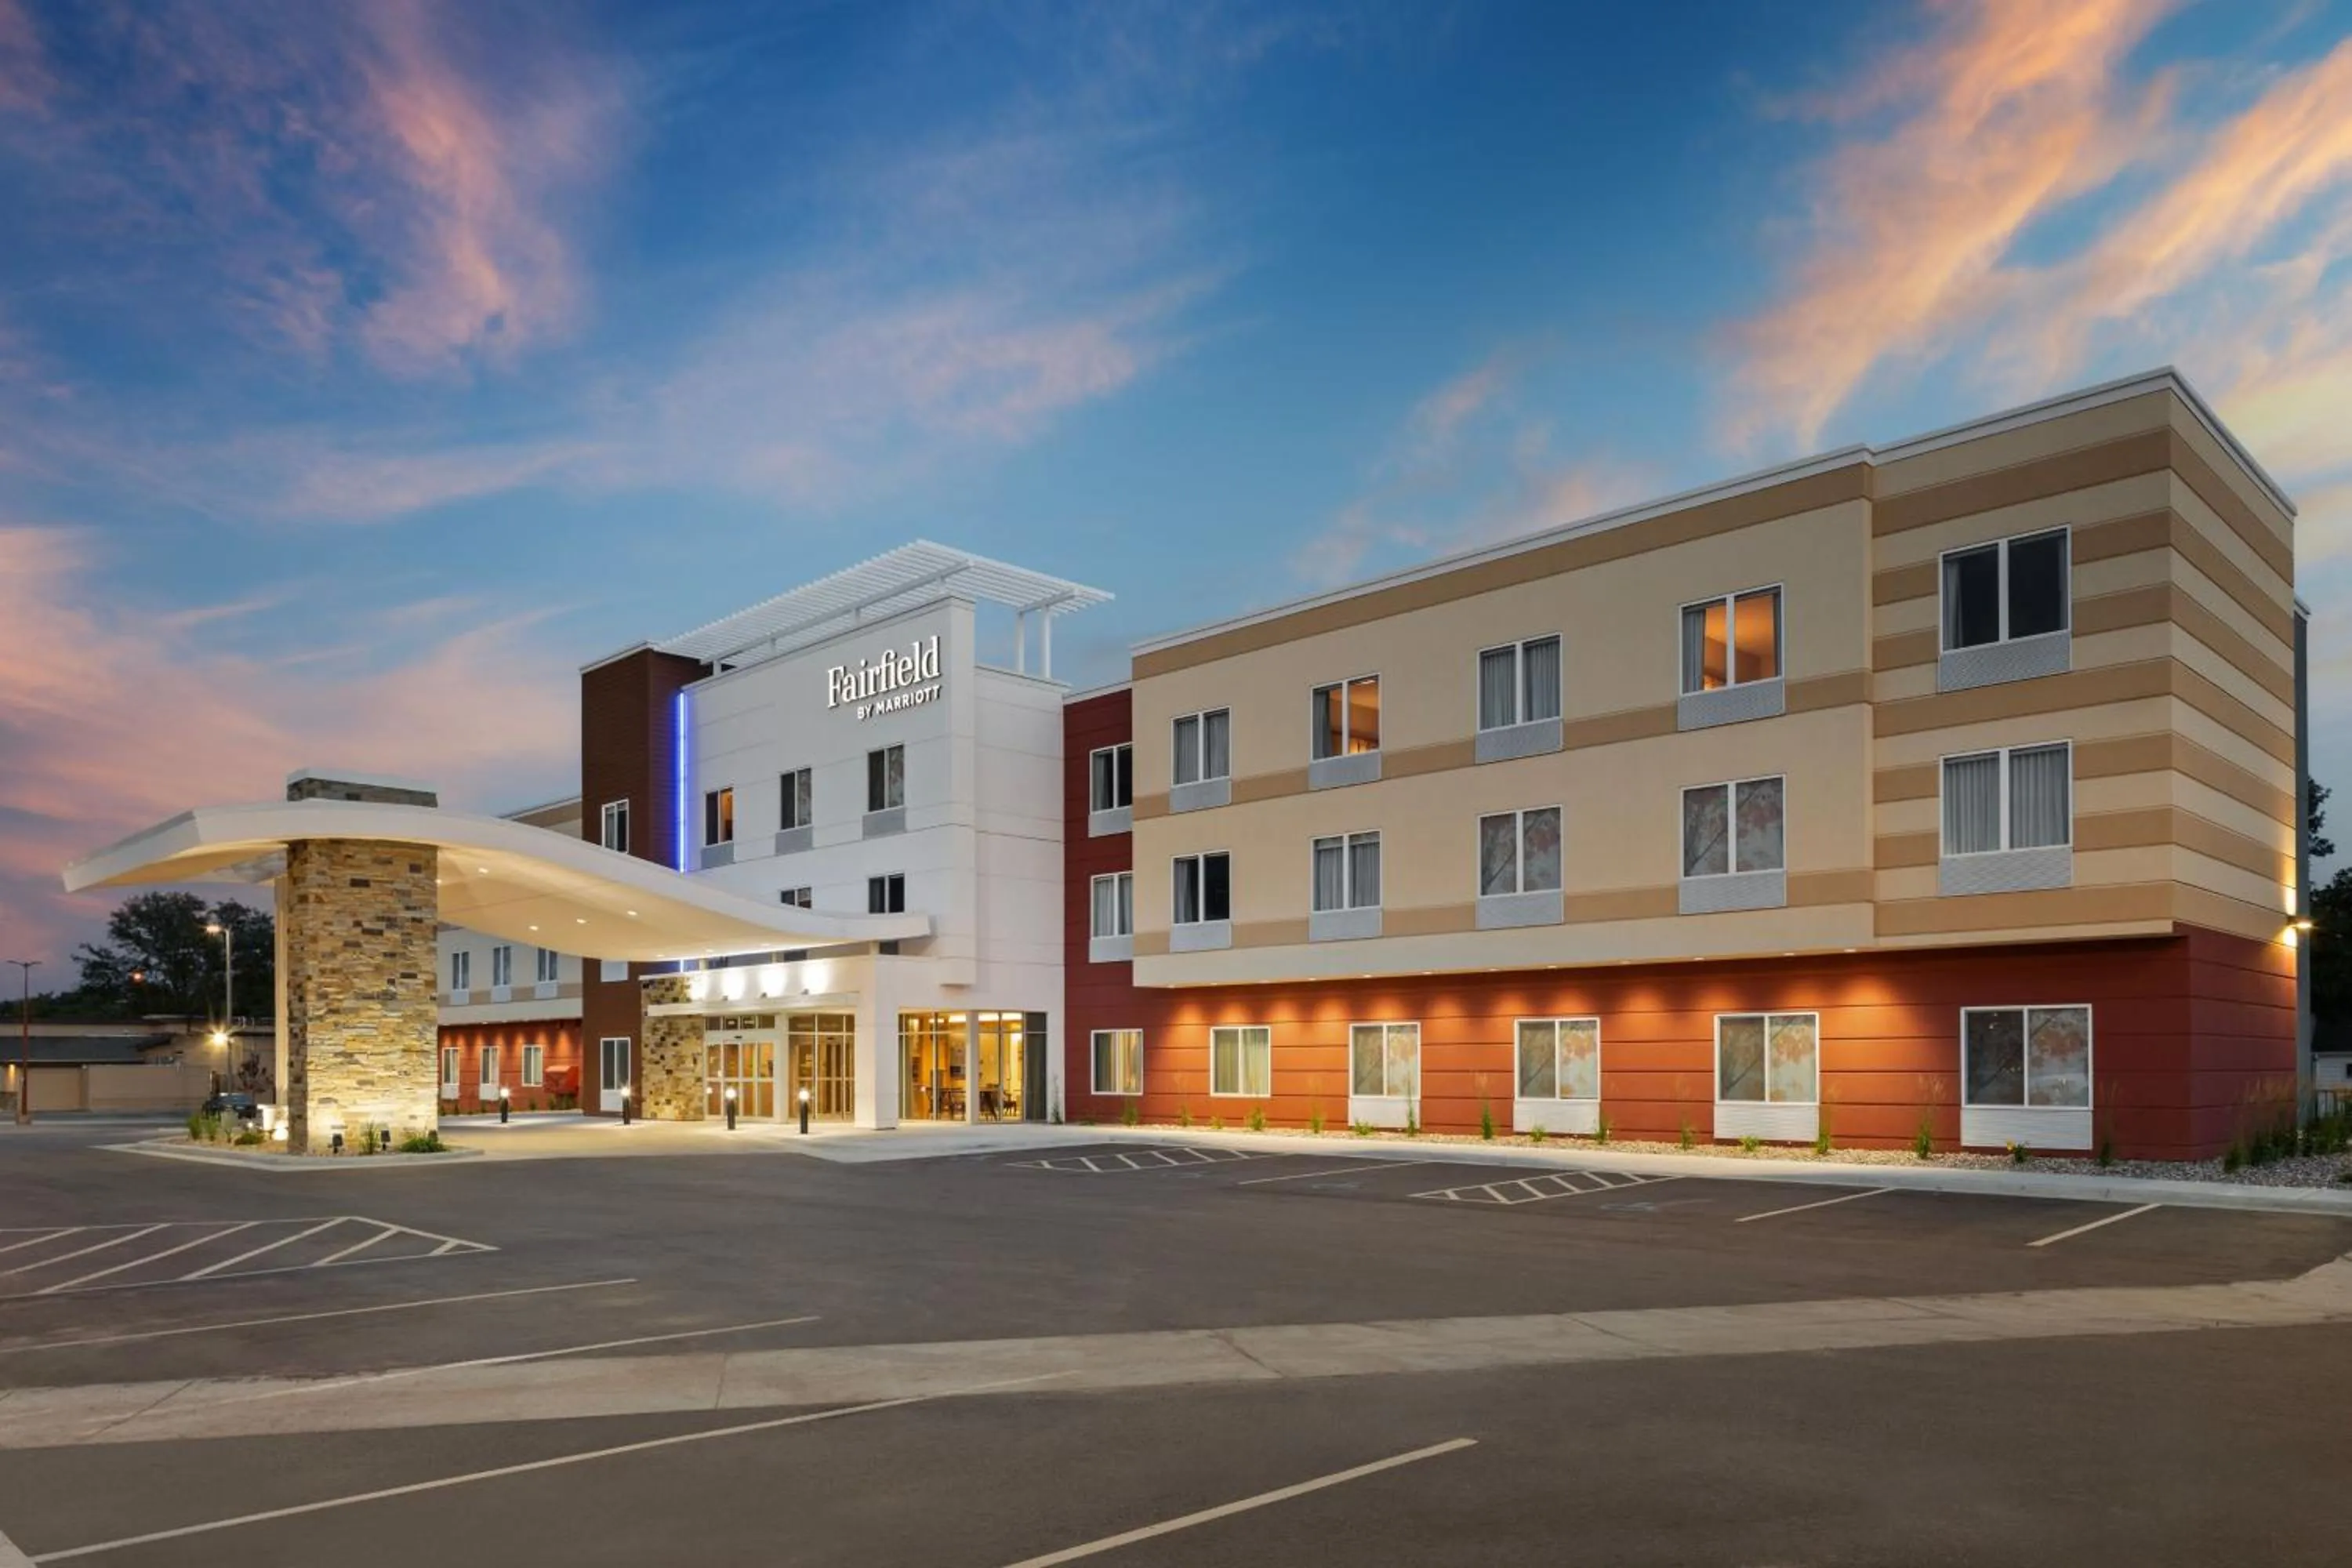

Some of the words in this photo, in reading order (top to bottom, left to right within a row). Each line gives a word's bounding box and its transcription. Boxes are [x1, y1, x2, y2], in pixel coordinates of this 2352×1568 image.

[827, 635, 941, 709] Fairfield
[857, 703, 873, 720] BY
[876, 684, 941, 715] MARRIOTT
